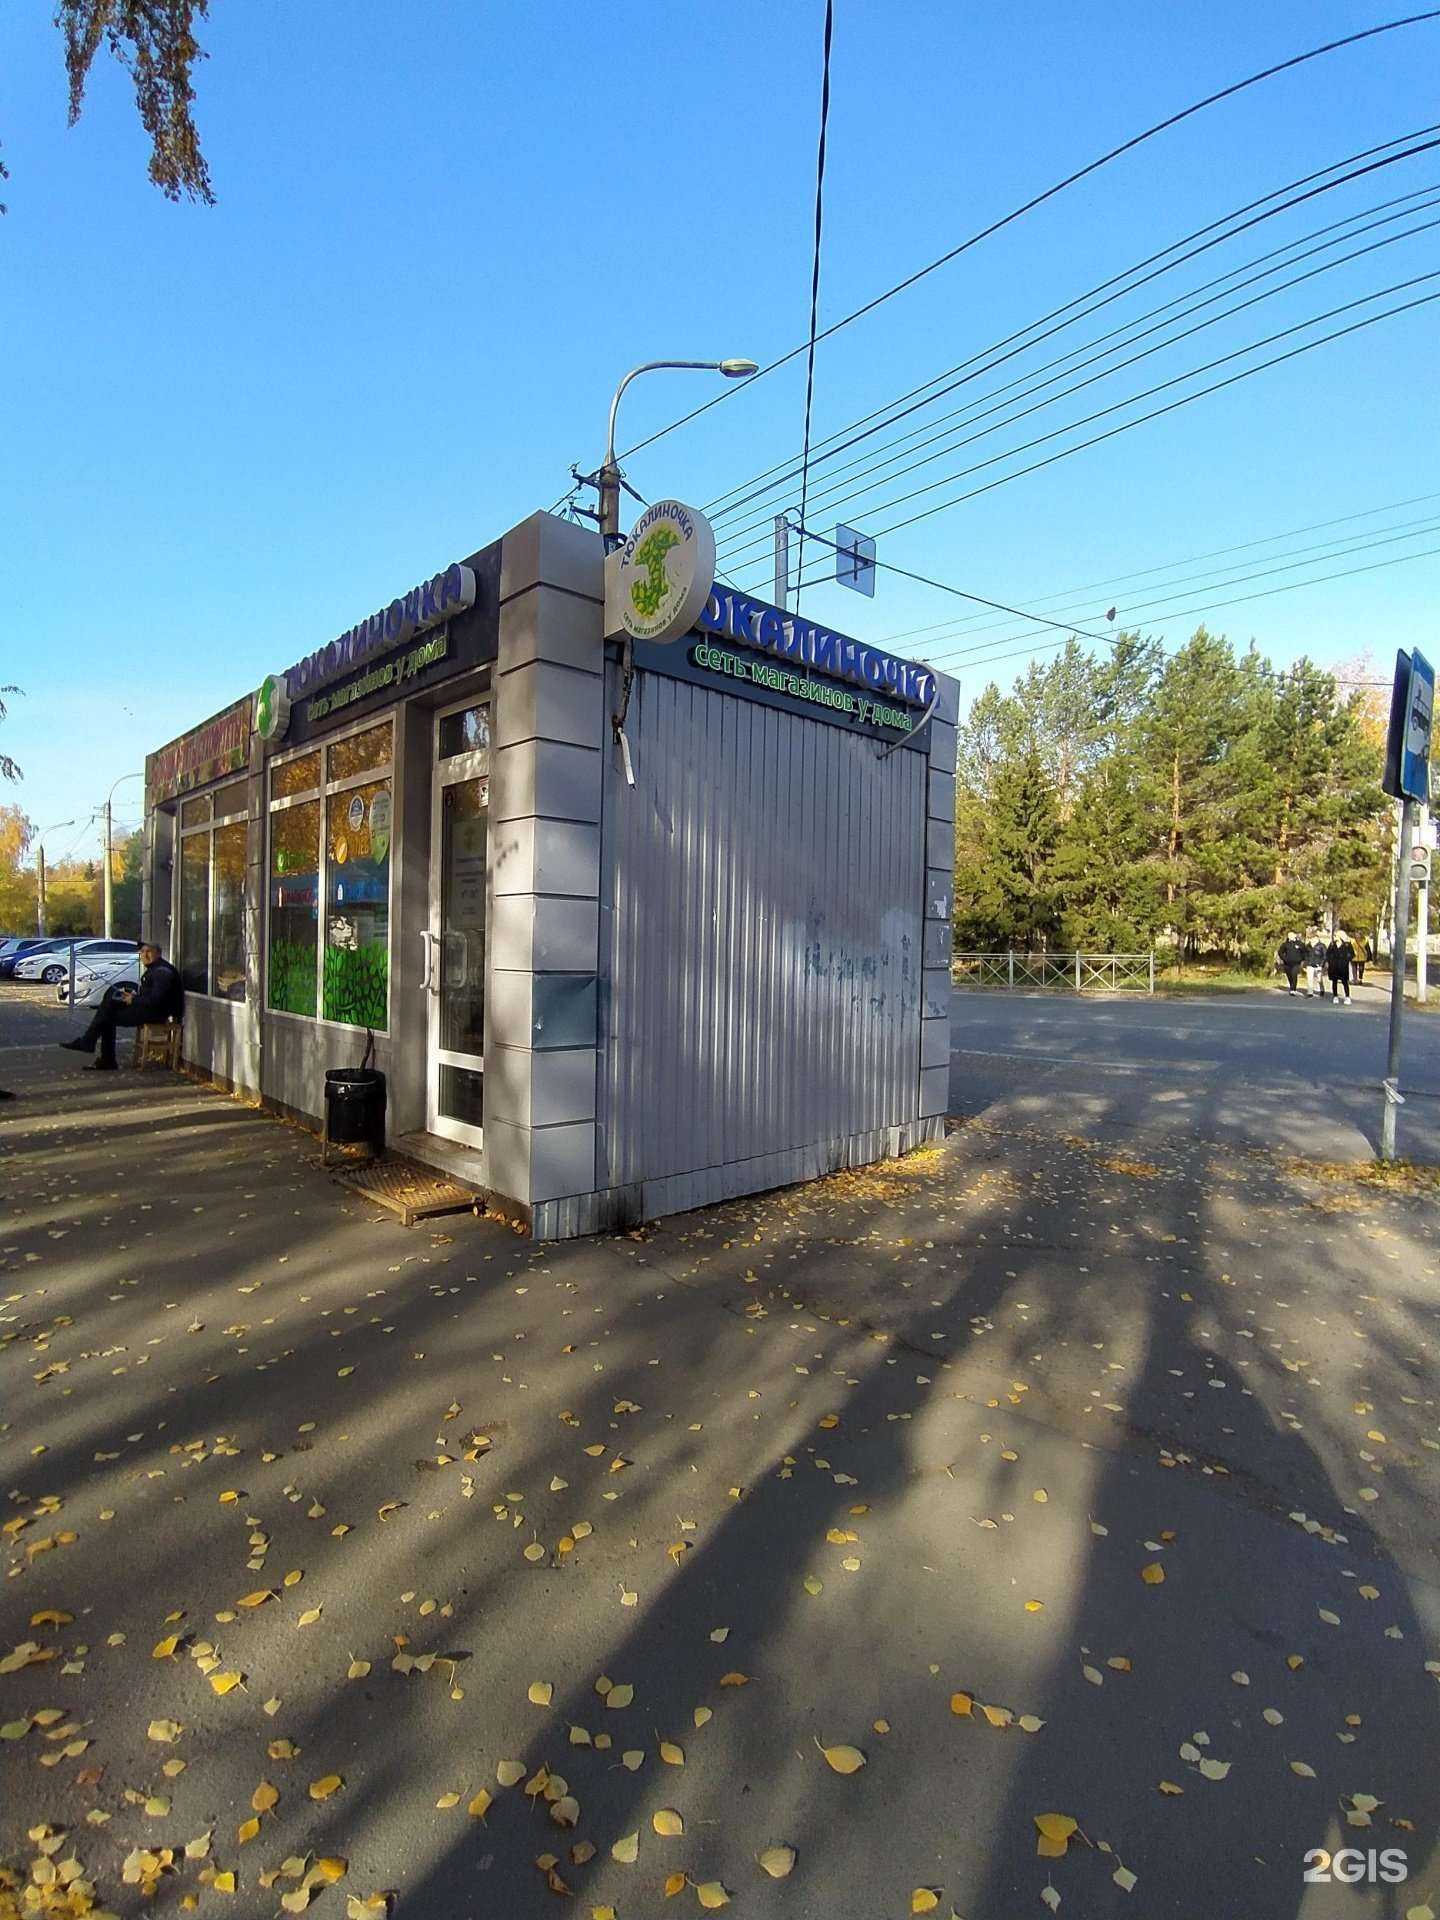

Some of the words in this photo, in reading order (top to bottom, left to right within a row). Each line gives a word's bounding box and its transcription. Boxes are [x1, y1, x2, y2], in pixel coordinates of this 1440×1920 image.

[620, 503, 694, 569] ТЮКАЛИНОЧКА
[695, 645, 746, 678] сеть
[752, 662, 854, 712] магазинов
[871, 704, 913, 732] дома
